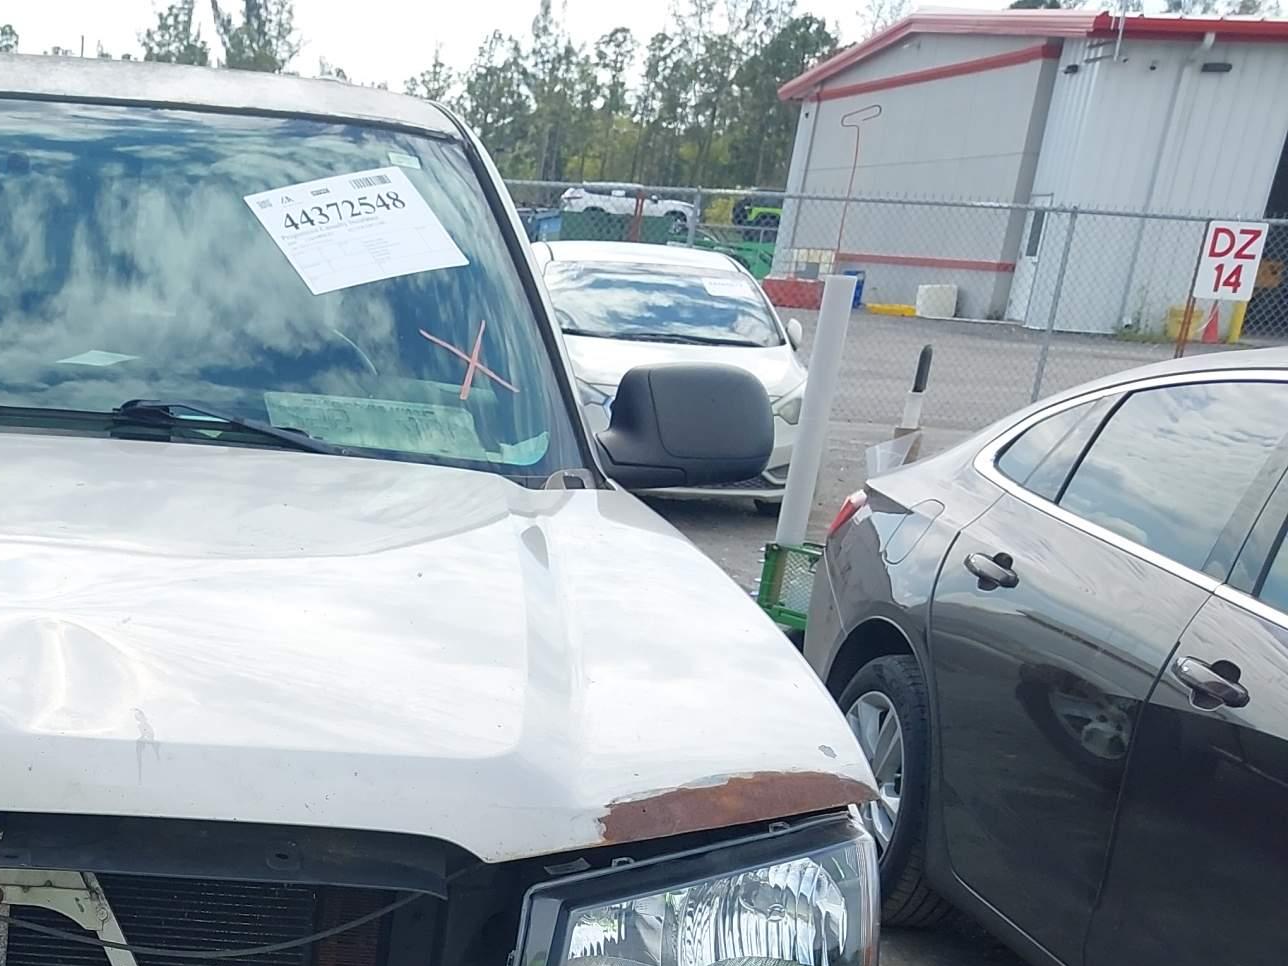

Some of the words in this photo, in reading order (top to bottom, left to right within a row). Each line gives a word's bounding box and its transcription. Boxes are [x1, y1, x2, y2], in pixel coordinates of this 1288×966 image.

[283, 191, 406, 231] 44372548
[1208, 227, 1263, 260] DZ
[1213, 263, 1243, 293] 14
